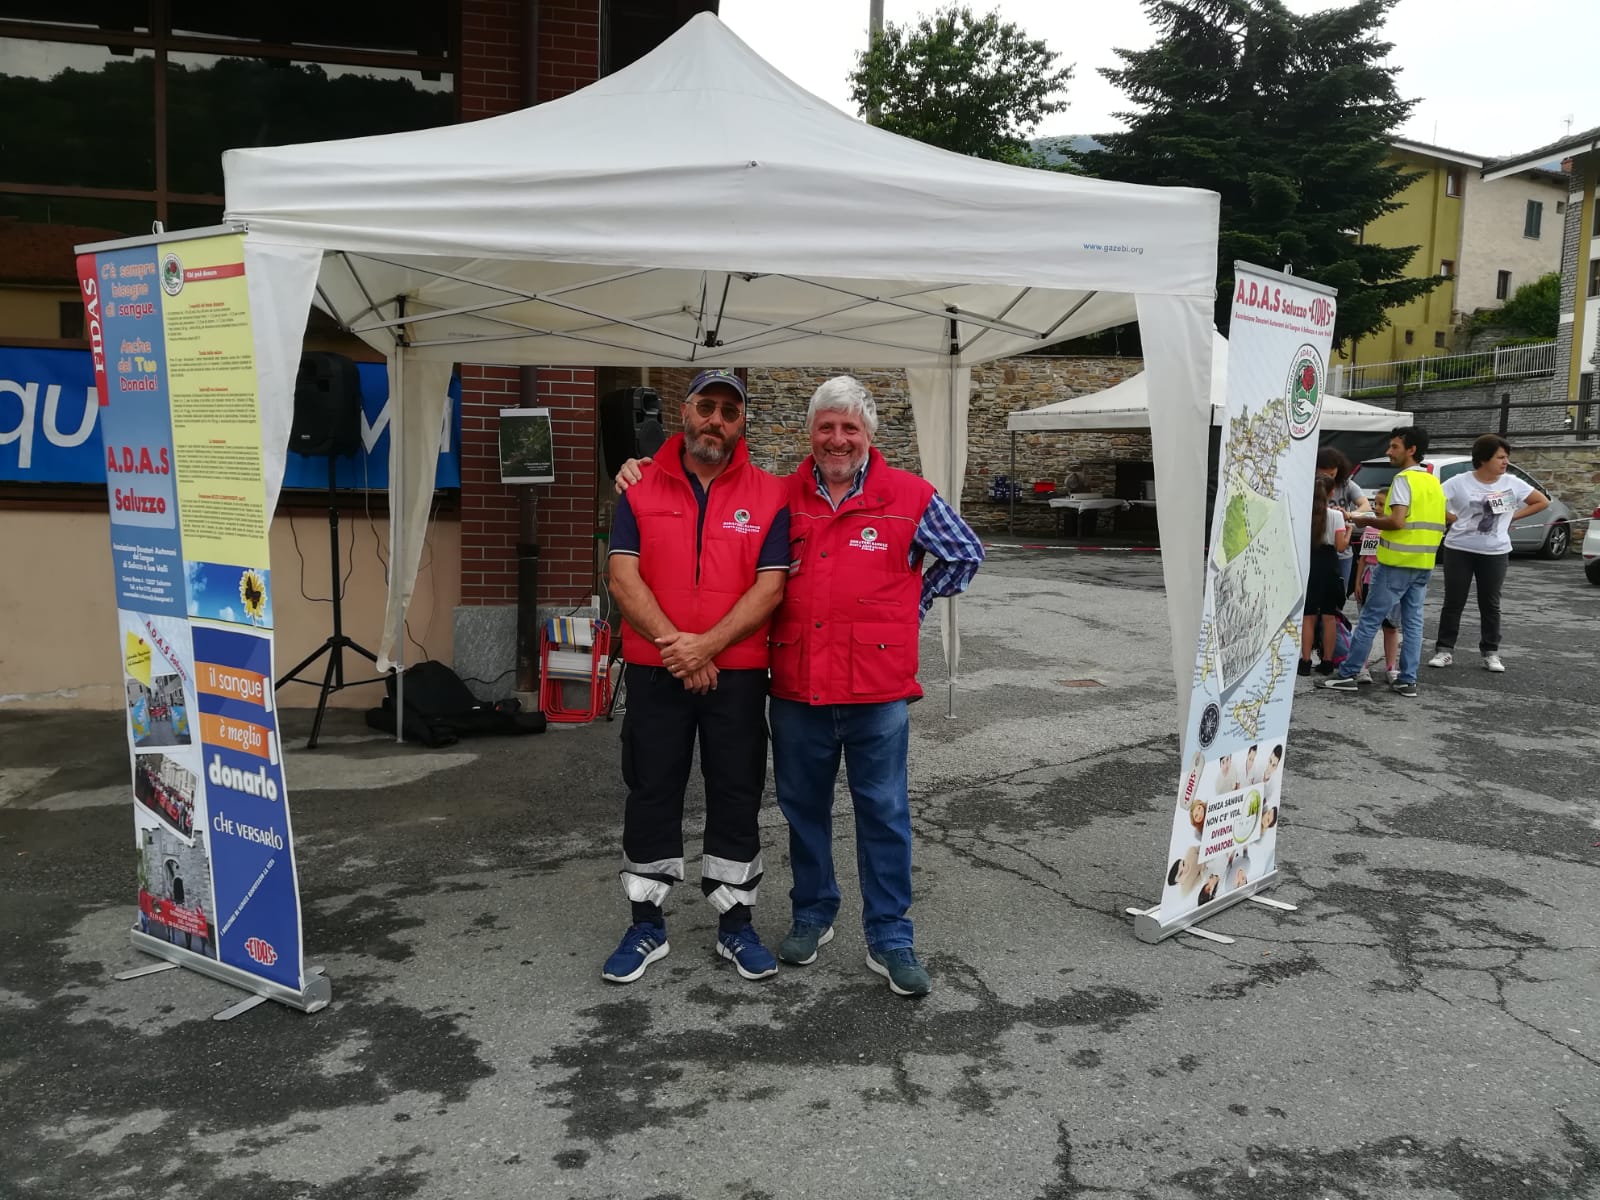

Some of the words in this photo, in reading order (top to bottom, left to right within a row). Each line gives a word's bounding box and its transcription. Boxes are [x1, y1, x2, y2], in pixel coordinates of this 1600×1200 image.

[1083, 242, 1144, 254] www.gazebi.org
[101, 262, 117, 280] C'è
[120, 262, 156, 281] sempre
[112, 282, 148, 300] bisogno
[1236, 279, 1281, 312] A.D.A.S
[1281, 299, 1307, 318] Saluzzo
[84, 278, 104, 373] FIDAS
[120, 337, 152, 353] Anche
[118, 359, 132, 373] del
[135, 357, 157, 373] Tuo
[120, 375, 159, 392] Donalo!
[107, 446, 170, 475] A.D.A.S
[115, 487, 166, 514] Saluzzo
[1363, 540, 1379, 550] 062
[209, 667, 216, 688] il
[219, 673, 262, 699] sangue
[219, 719, 226, 738] è
[227, 724, 262, 750] meglio
[208, 753, 278, 802] donarlo
[1207, 802, 1223, 813] SENZA
[1224, 794, 1244, 807] SANGUE
[1206, 816, 1219, 828] NON
[1211, 825, 1233, 840] DIVENTA
